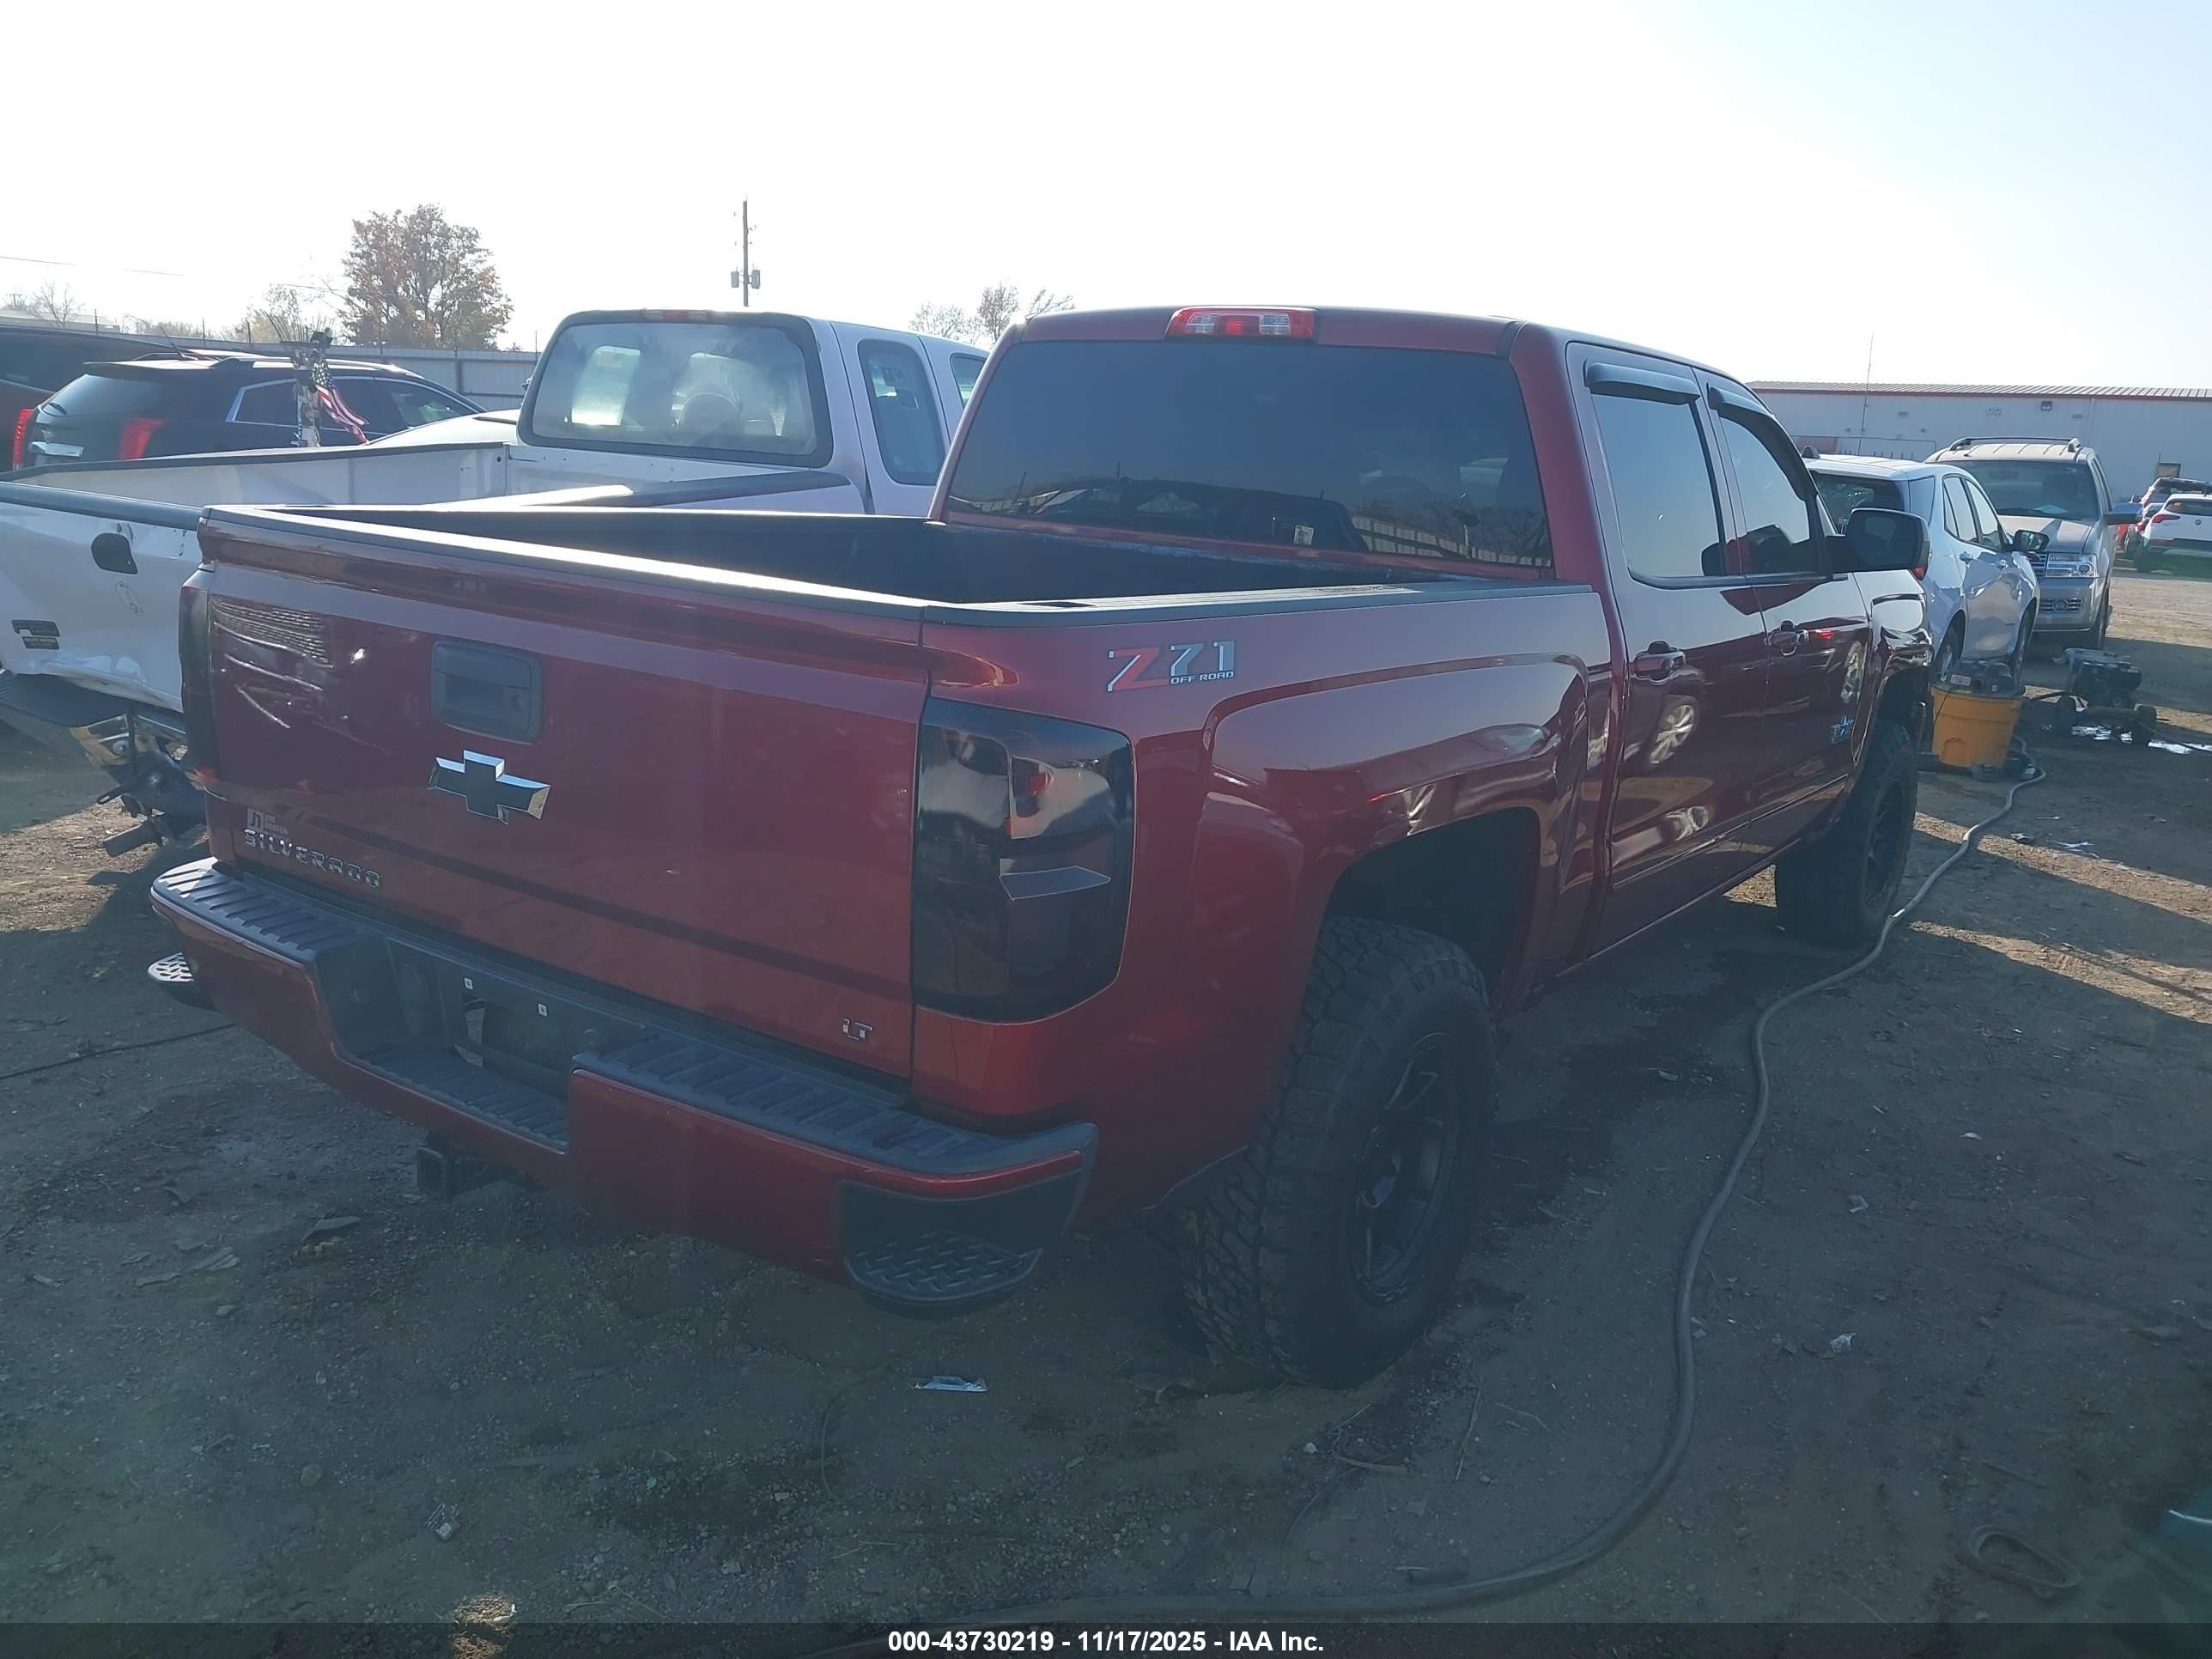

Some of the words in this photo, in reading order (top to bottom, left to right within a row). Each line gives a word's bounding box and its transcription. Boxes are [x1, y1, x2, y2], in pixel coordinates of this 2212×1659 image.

[1107, 640, 1236, 692] Z71
[1170, 675, 1196, 685] OFF
[1199, 671, 1235, 682] ROAD
[244, 828, 380, 889] SILVERADO
[842, 1018, 873, 1041] LT
